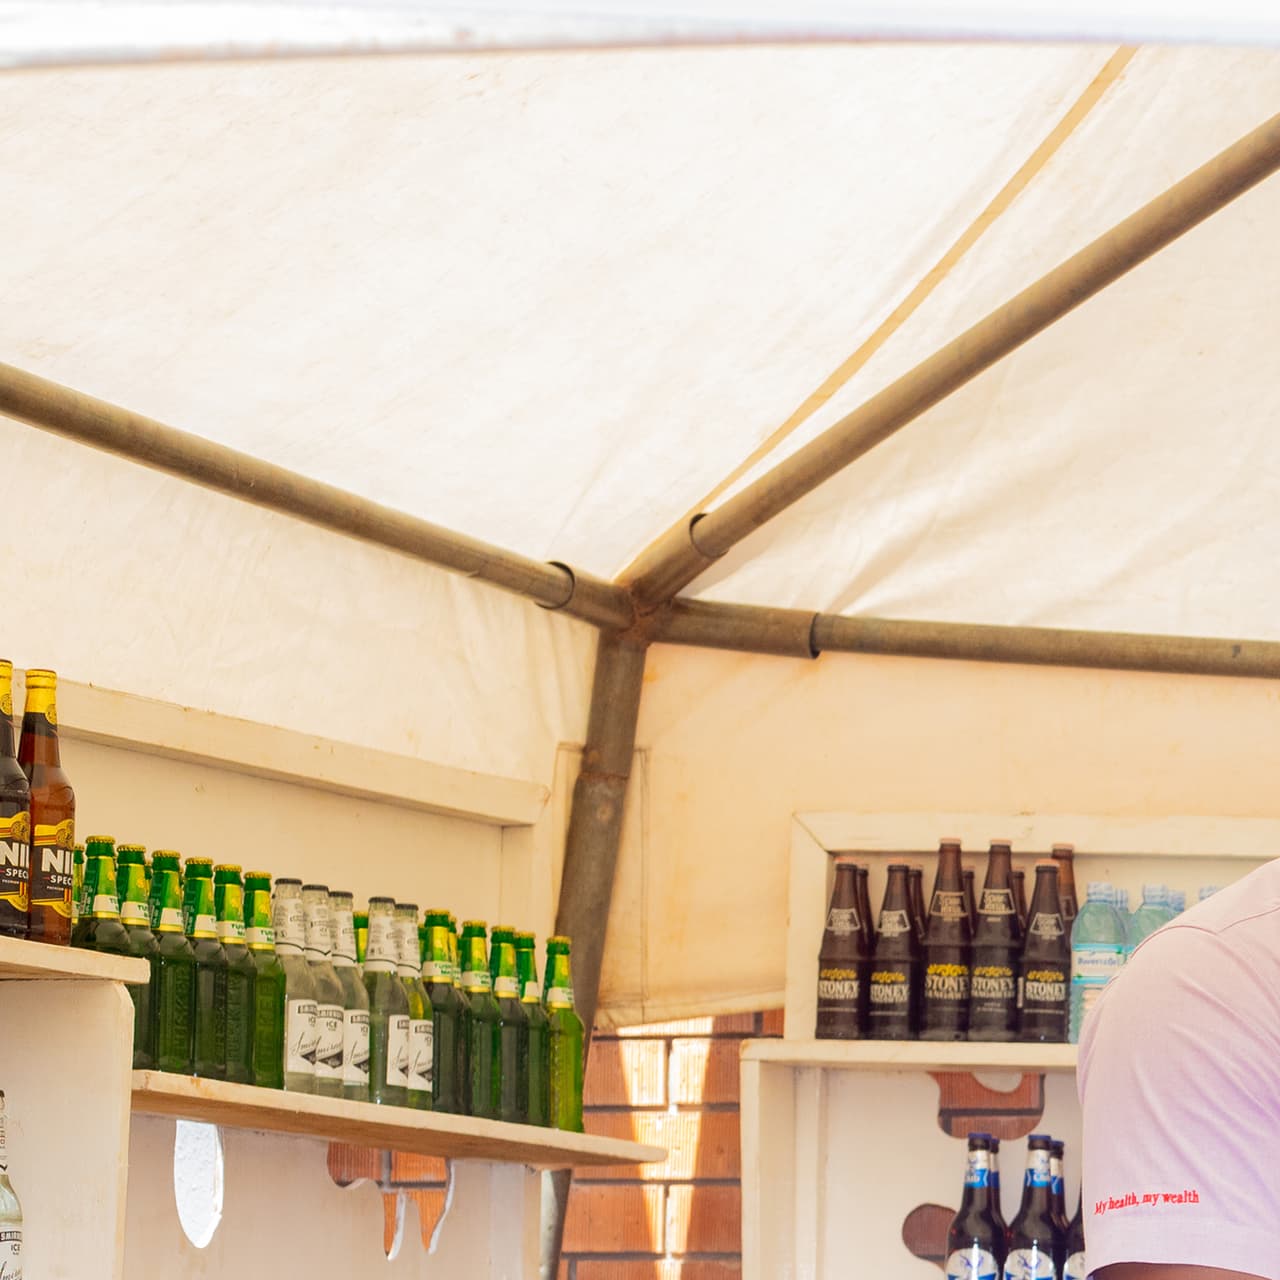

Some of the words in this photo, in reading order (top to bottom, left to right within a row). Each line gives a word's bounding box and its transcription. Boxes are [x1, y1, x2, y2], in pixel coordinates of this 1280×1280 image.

[1026, 982, 1066, 995] STONEY
[1108, 1191, 1140, 1210] health,
[1142, 1192, 1159, 1206] my
[1162, 1189, 1200, 1204] wealth
